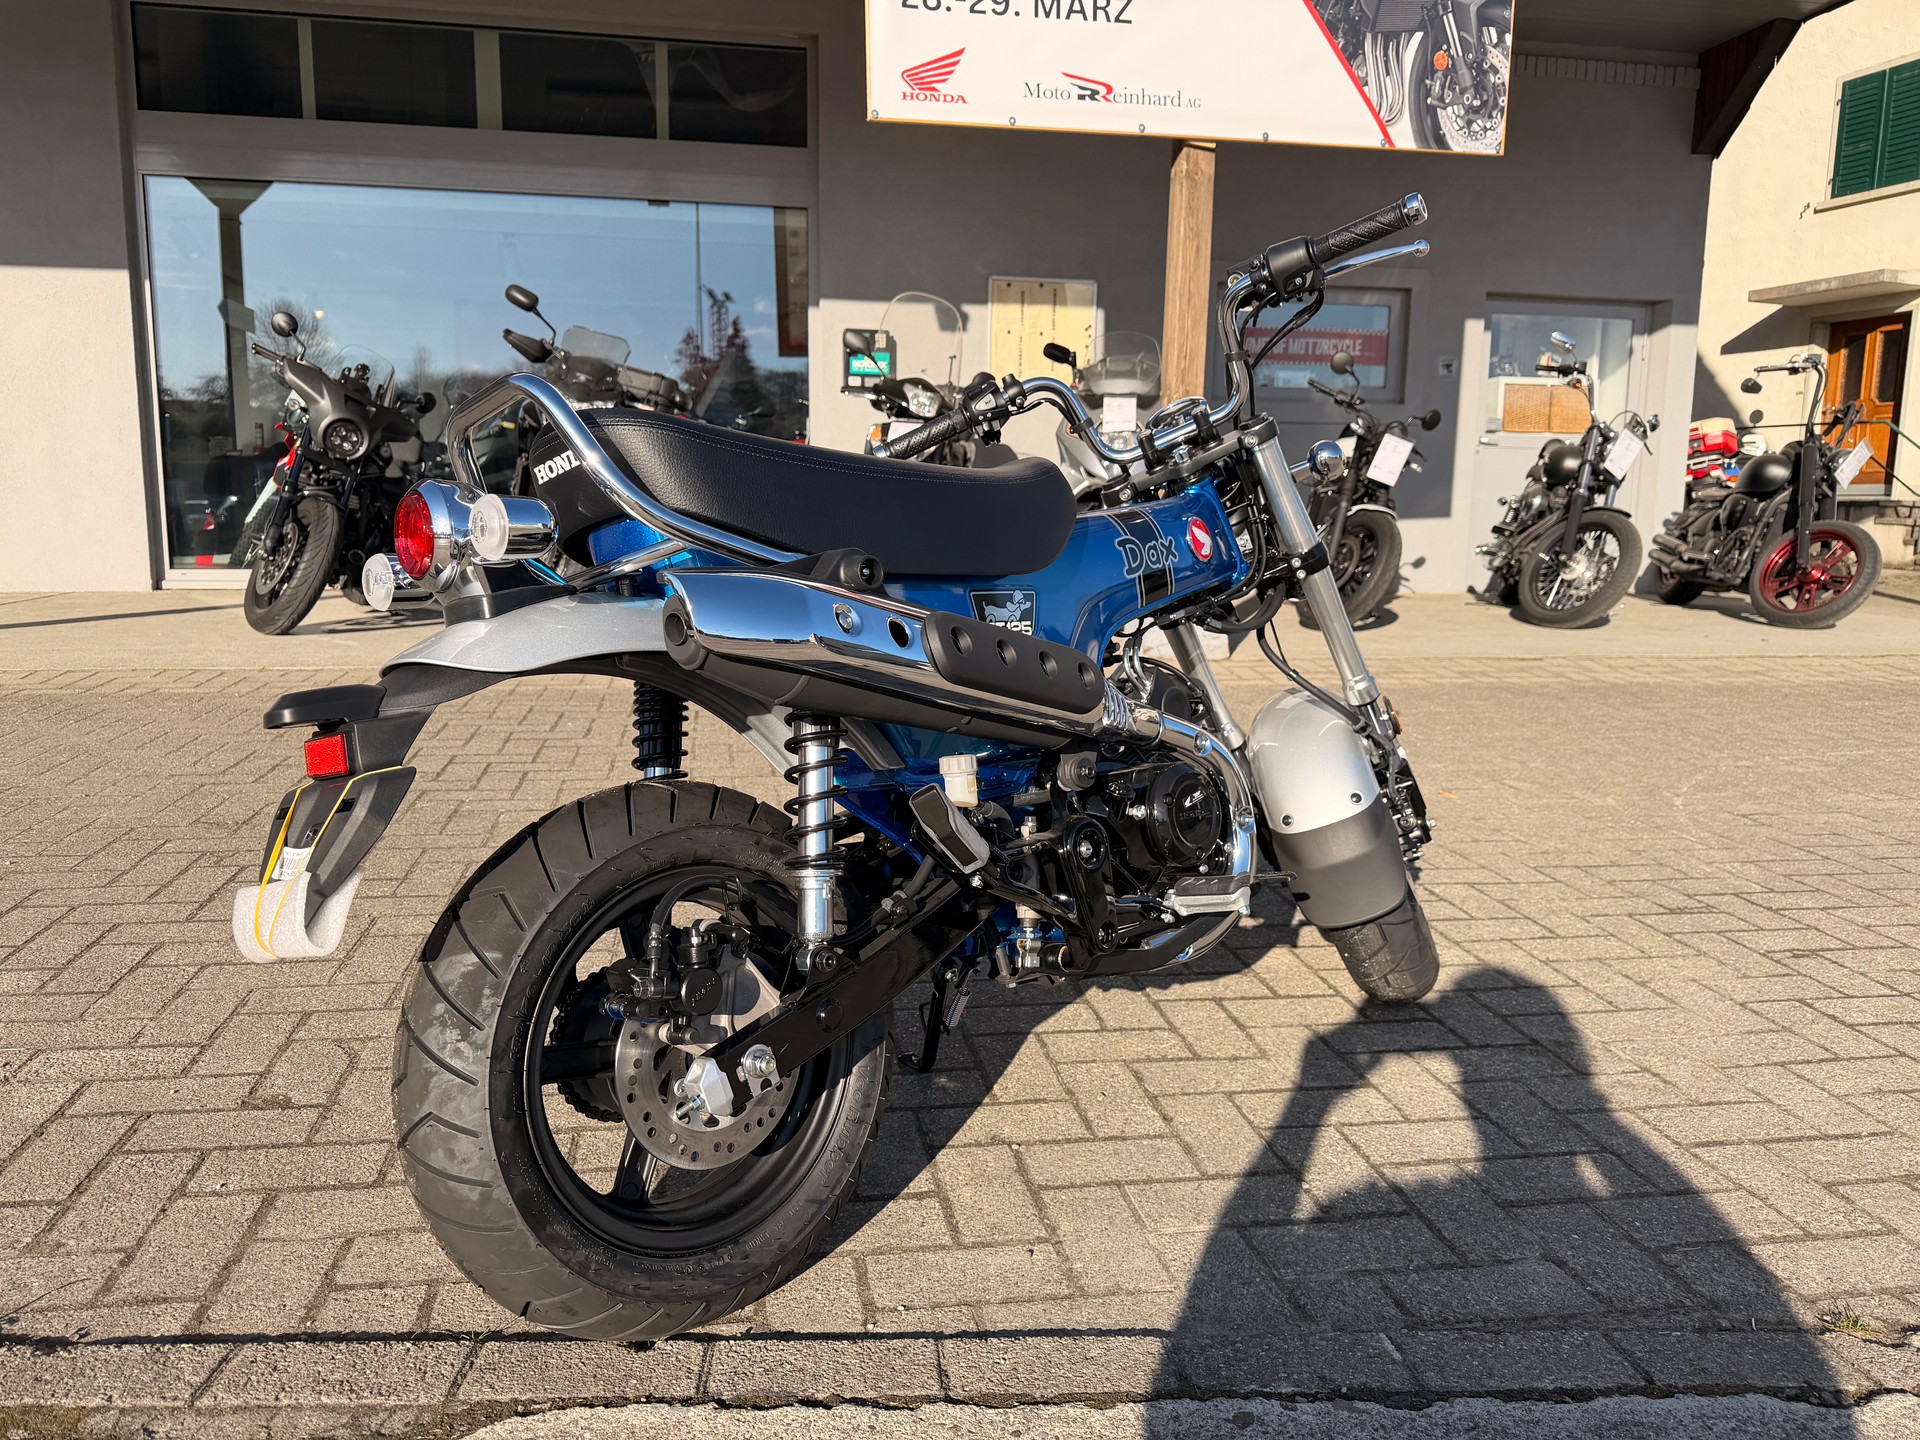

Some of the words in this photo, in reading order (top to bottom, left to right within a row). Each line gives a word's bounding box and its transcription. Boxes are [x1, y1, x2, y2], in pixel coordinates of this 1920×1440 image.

[901, 91, 968, 104] HONDA
[1023, 82, 1071, 101] Moto
[1185, 97, 1201, 109] AG
[533, 449, 581, 485] HON
[1115, 536, 1179, 578] Dax
